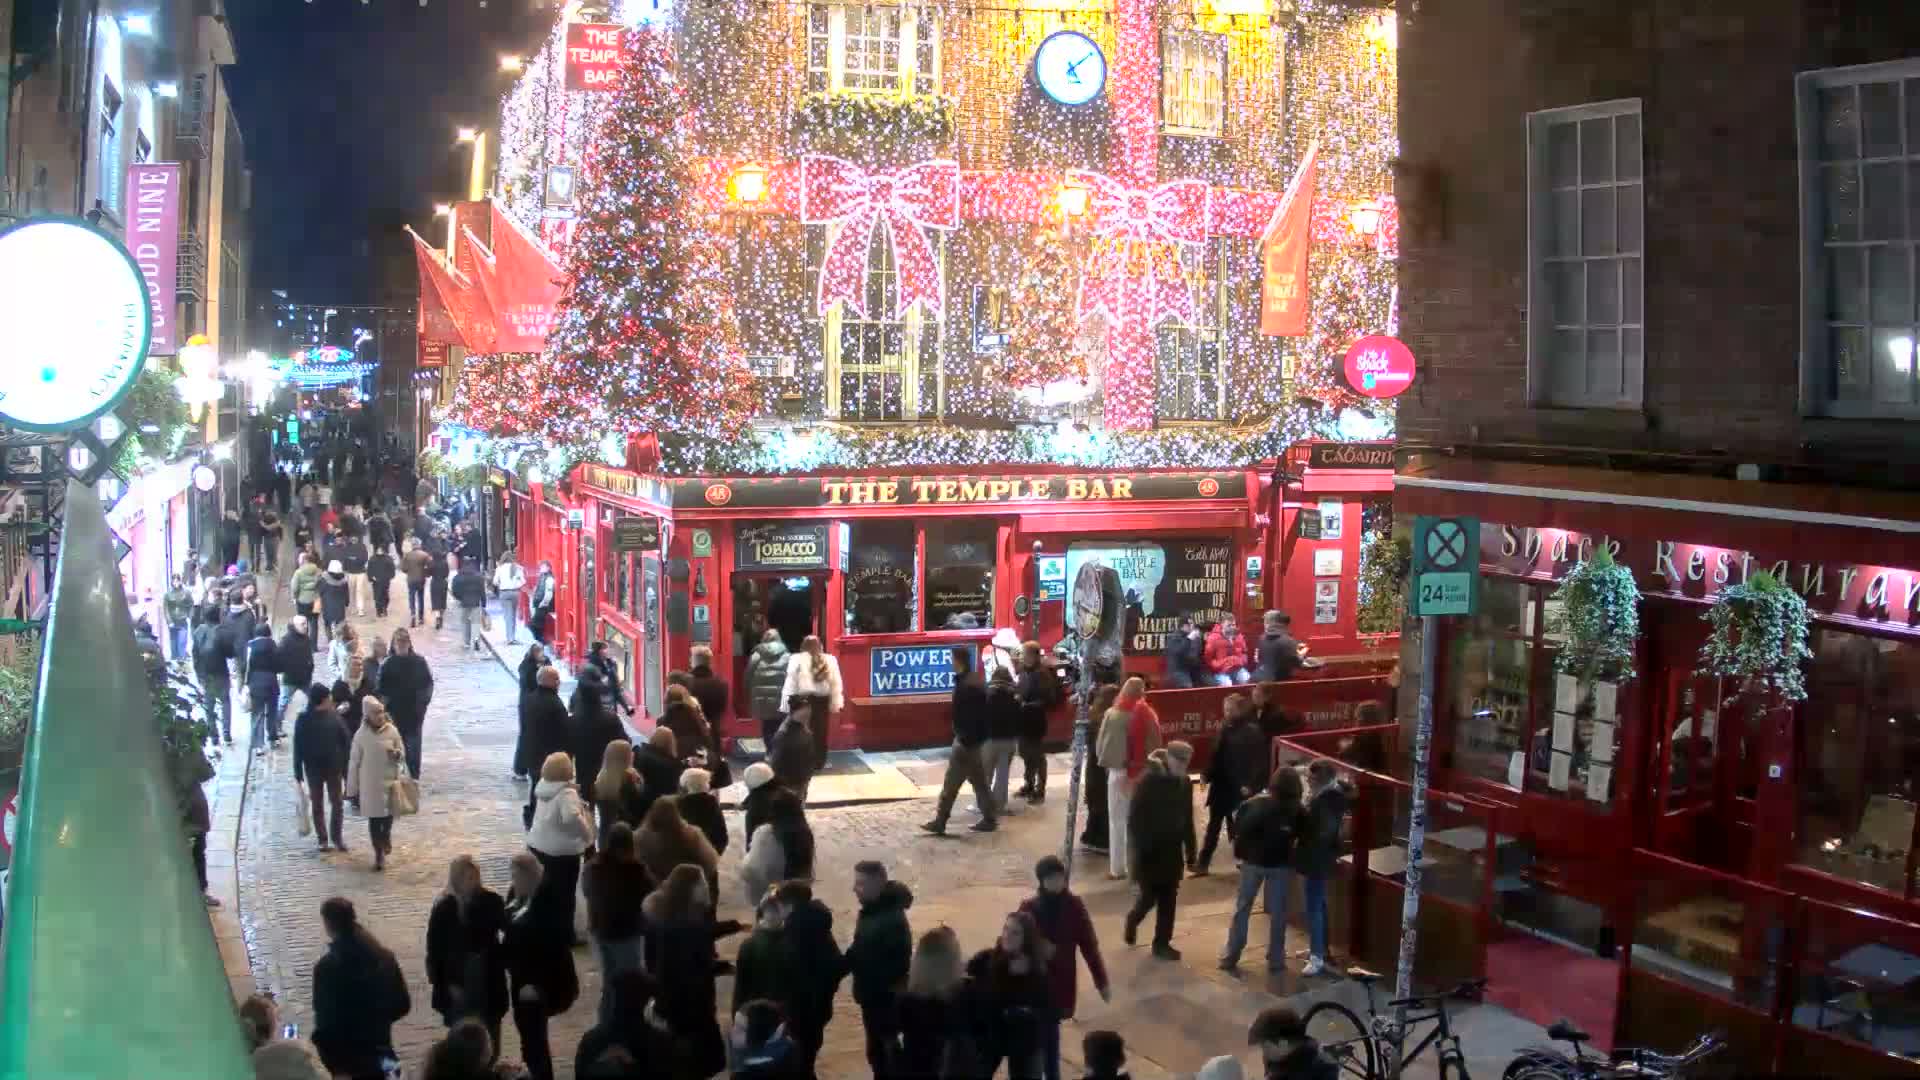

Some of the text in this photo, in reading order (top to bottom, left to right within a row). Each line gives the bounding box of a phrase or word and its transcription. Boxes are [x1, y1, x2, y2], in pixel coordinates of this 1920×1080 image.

[585, 29, 617, 45] THE
[136, 171, 169, 232] NINE
[824, 478, 1133, 504] THE TEMPLE BAR
[753, 542, 817, 562] TOBACCO
[1501, 524, 1621, 566] Shack
[1111, 557, 1158, 569] TEMPLE
[1204, 563, 1227, 577] THE
[1122, 568, 1146, 579] BAR
[1176, 578, 1227, 593] EMPEROR
[1422, 584, 1444, 602] 24
[1212, 593, 1225, 607] OF
